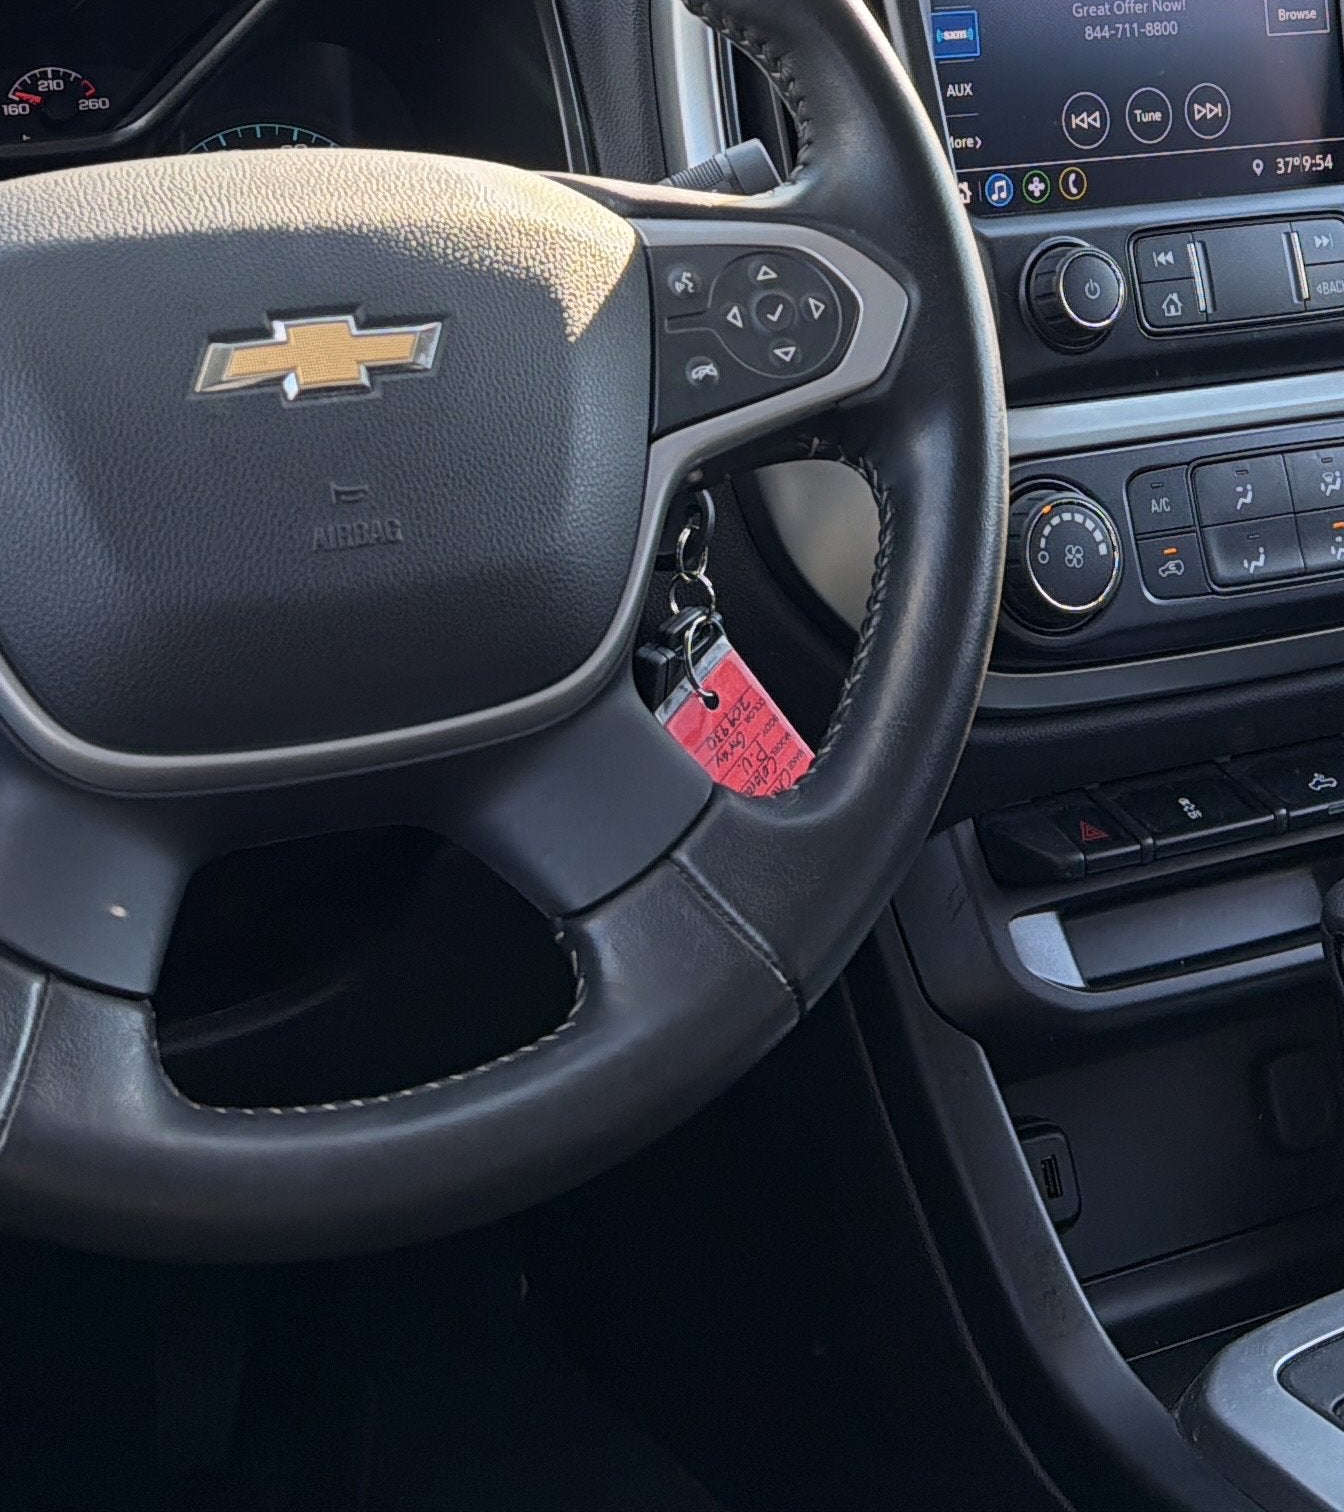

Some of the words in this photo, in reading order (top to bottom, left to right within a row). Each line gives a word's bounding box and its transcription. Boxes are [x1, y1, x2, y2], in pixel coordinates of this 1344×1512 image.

[1072, 2, 1111, 17] Great
[1113, 0, 1149, 15] Offer
[1278, 6, 1317, 22] Browse
[1084, 21, 1178, 41] 844-711-8800
[38, 78, 65, 92] 210
[946, 82, 973, 98] AUX
[1, 102, 31, 117] 160
[78, 96, 110, 111] 260
[1133, 108, 1162, 123] Tune
[1302, 153, 1334, 172] 9:54
[1150, 496, 1171, 514] A/C
[312, 518, 404, 551] AIRBAG
